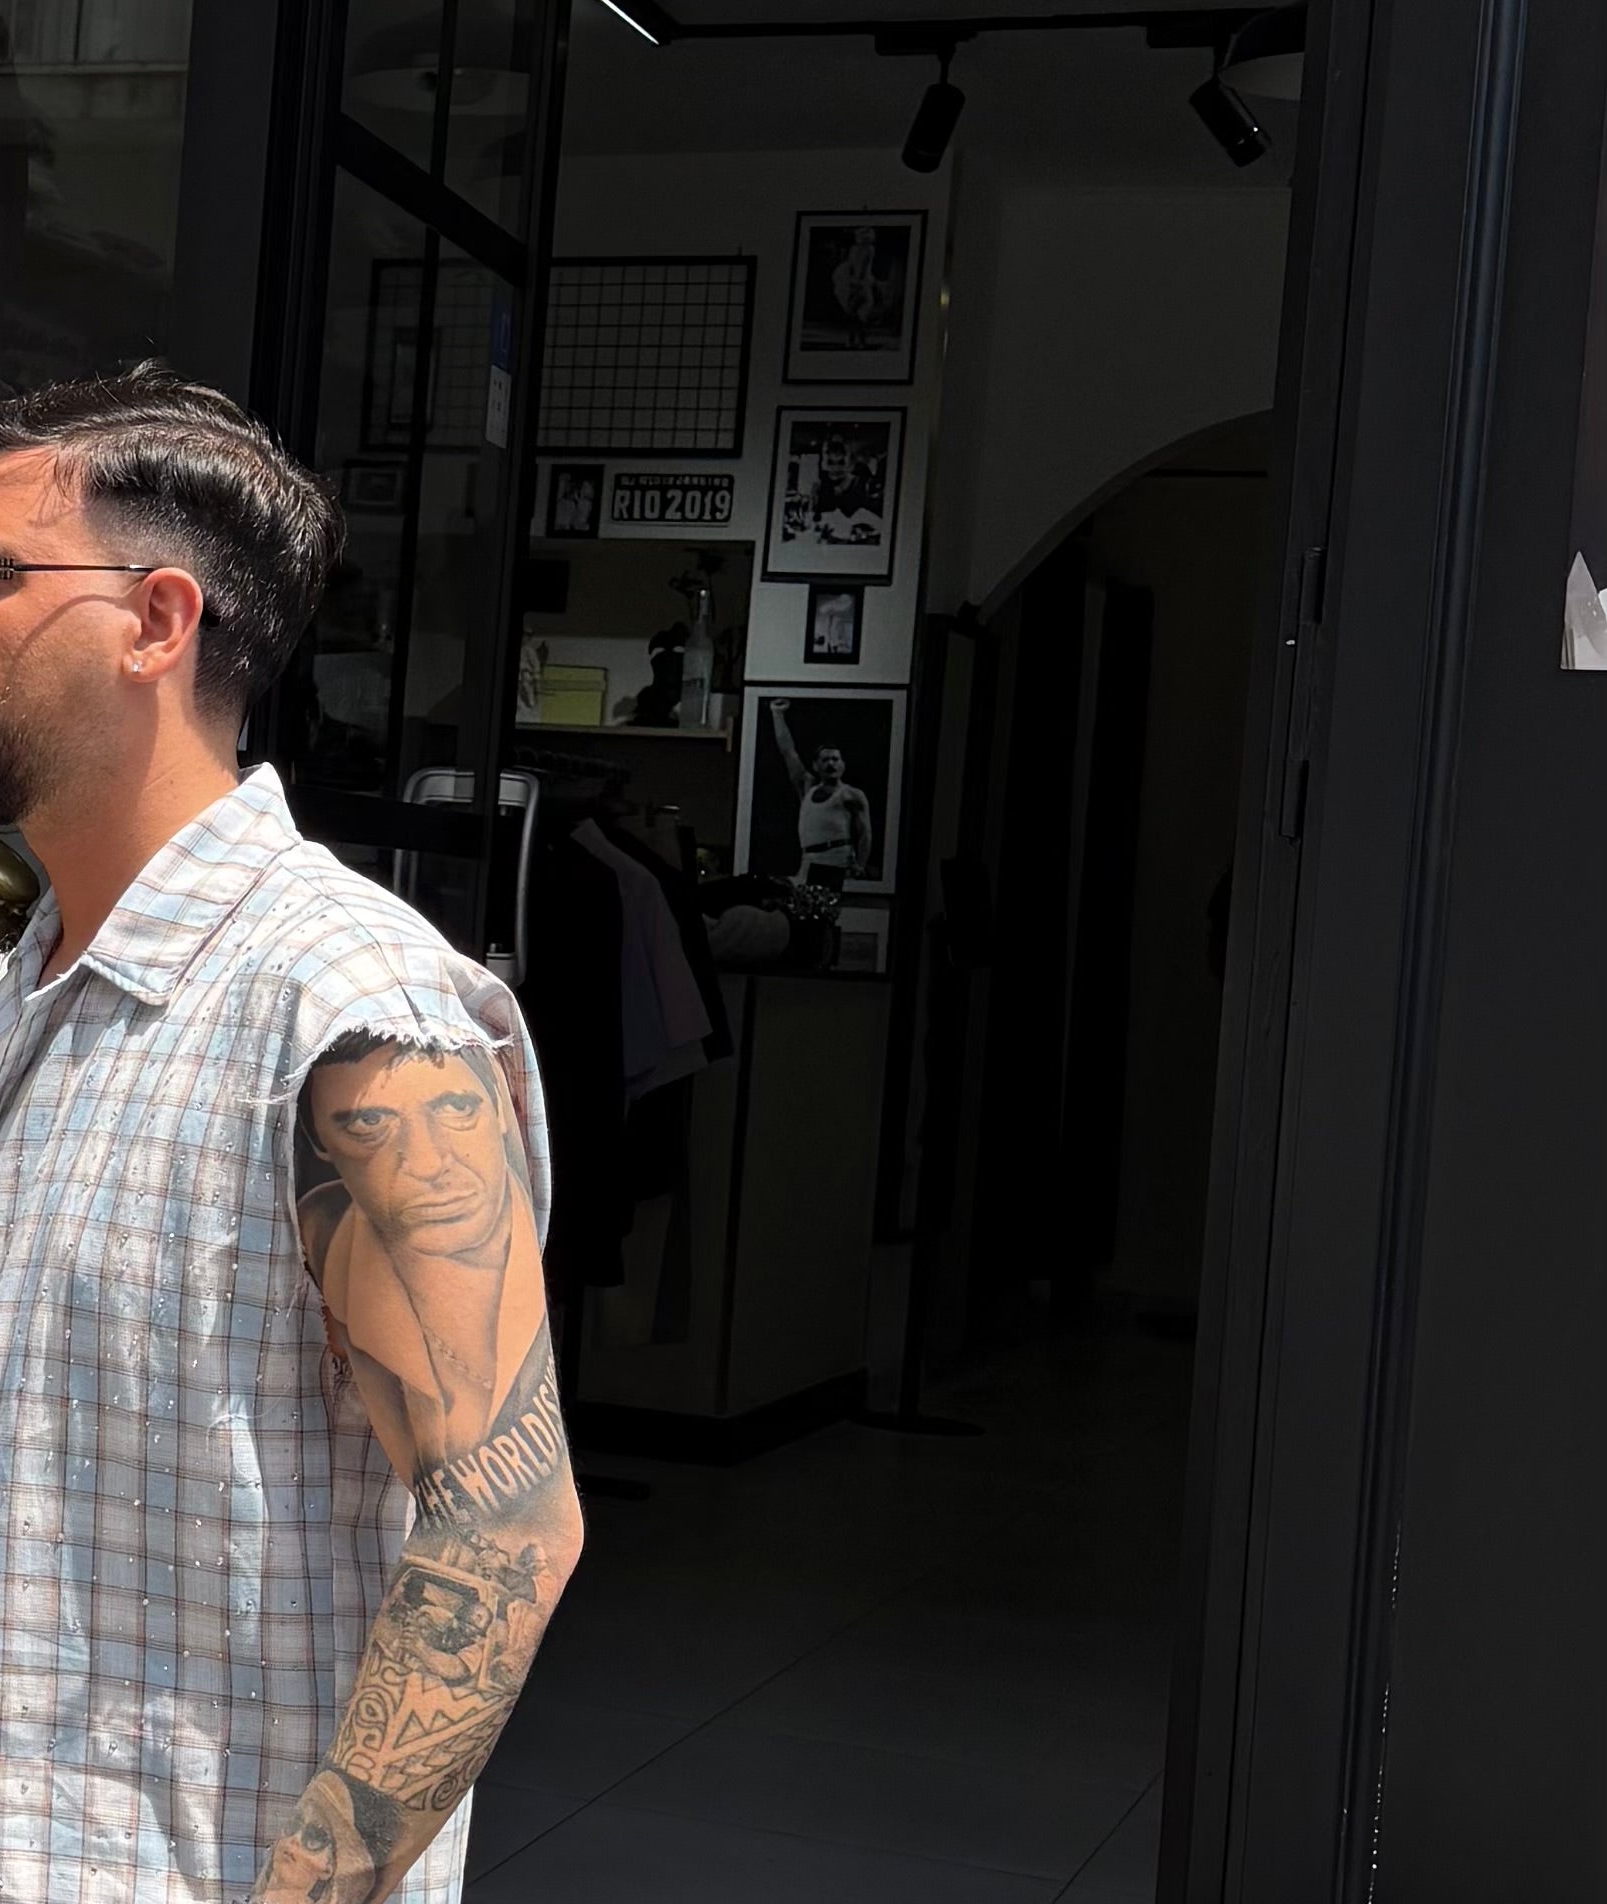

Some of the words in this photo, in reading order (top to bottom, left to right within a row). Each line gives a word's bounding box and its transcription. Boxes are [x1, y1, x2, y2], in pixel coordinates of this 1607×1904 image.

[613, 489, 661, 520] RIO
[665, 488, 731, 520] 2019
[449, 1412, 559, 1515] WORLD
